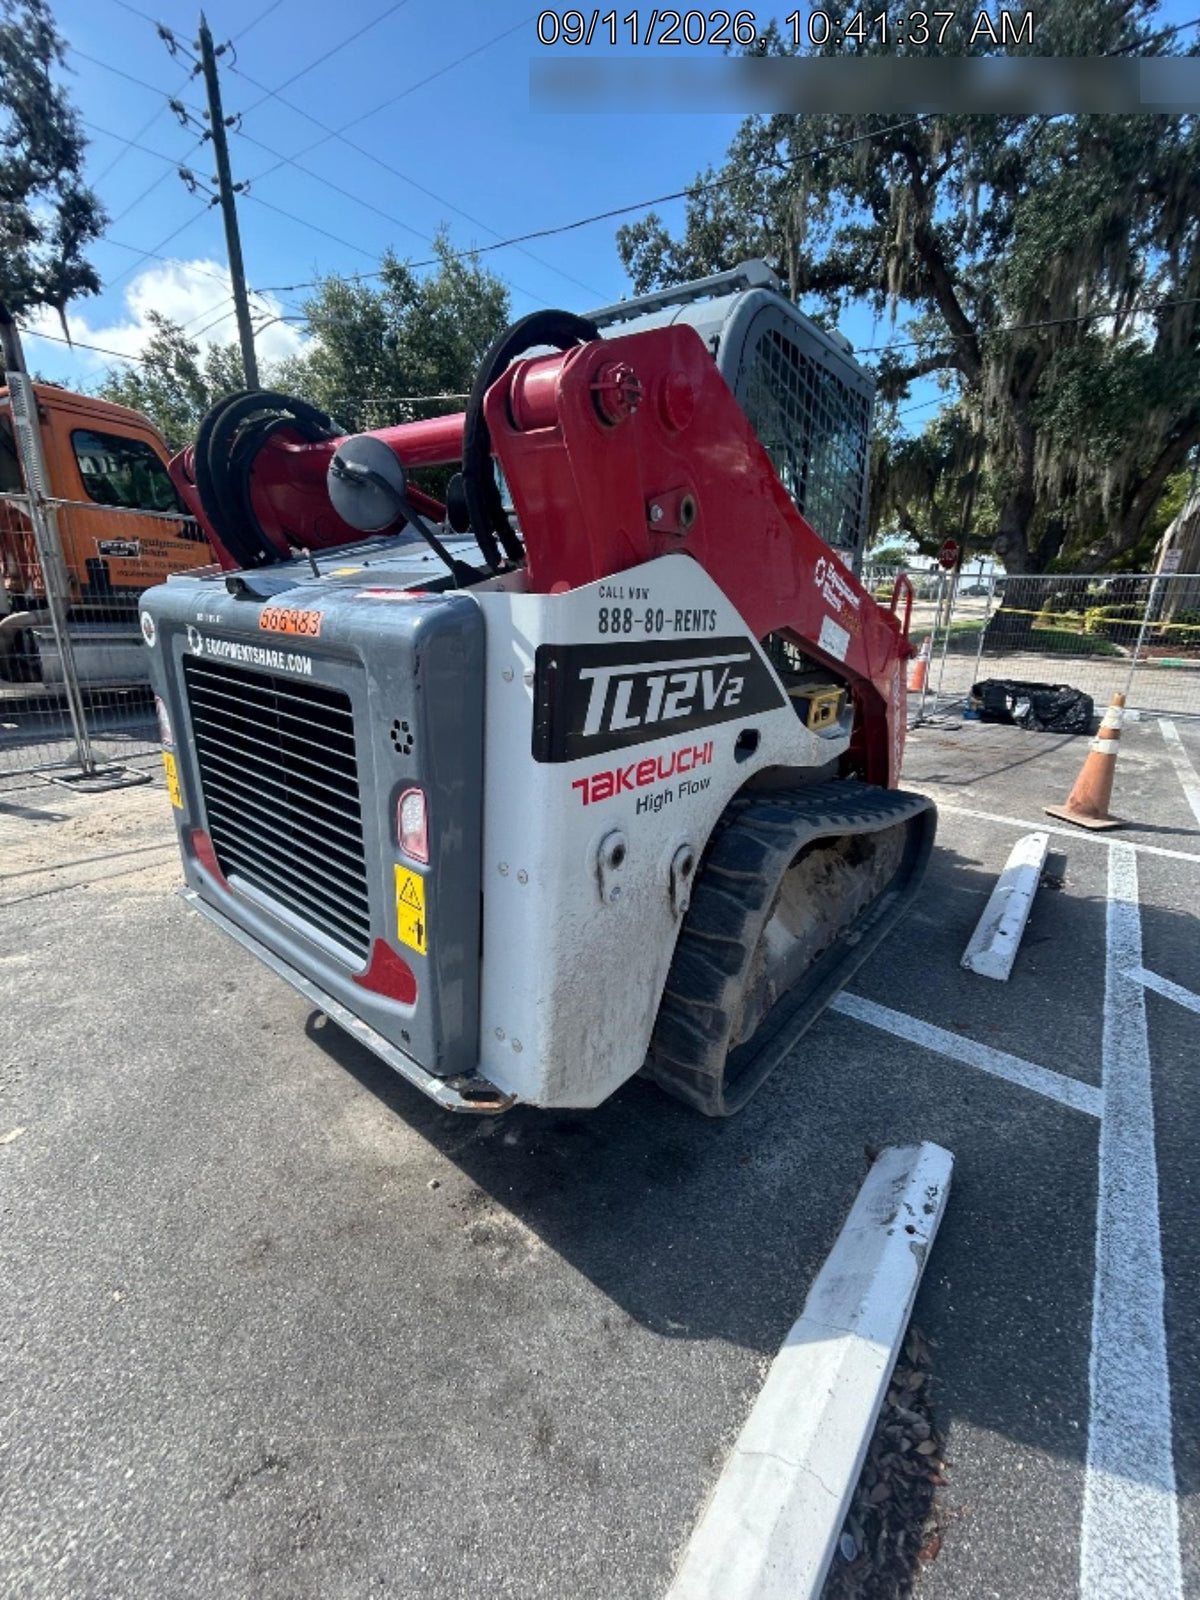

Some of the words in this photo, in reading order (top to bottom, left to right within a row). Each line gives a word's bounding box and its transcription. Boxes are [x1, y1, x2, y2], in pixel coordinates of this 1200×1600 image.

[599, 585, 625, 599] CALL
[628, 586, 650, 600] NOW
[598, 607, 717, 634] 888-80-RENTS
[636, 788, 673, 815] High
[678, 777, 712, 798] Flow
